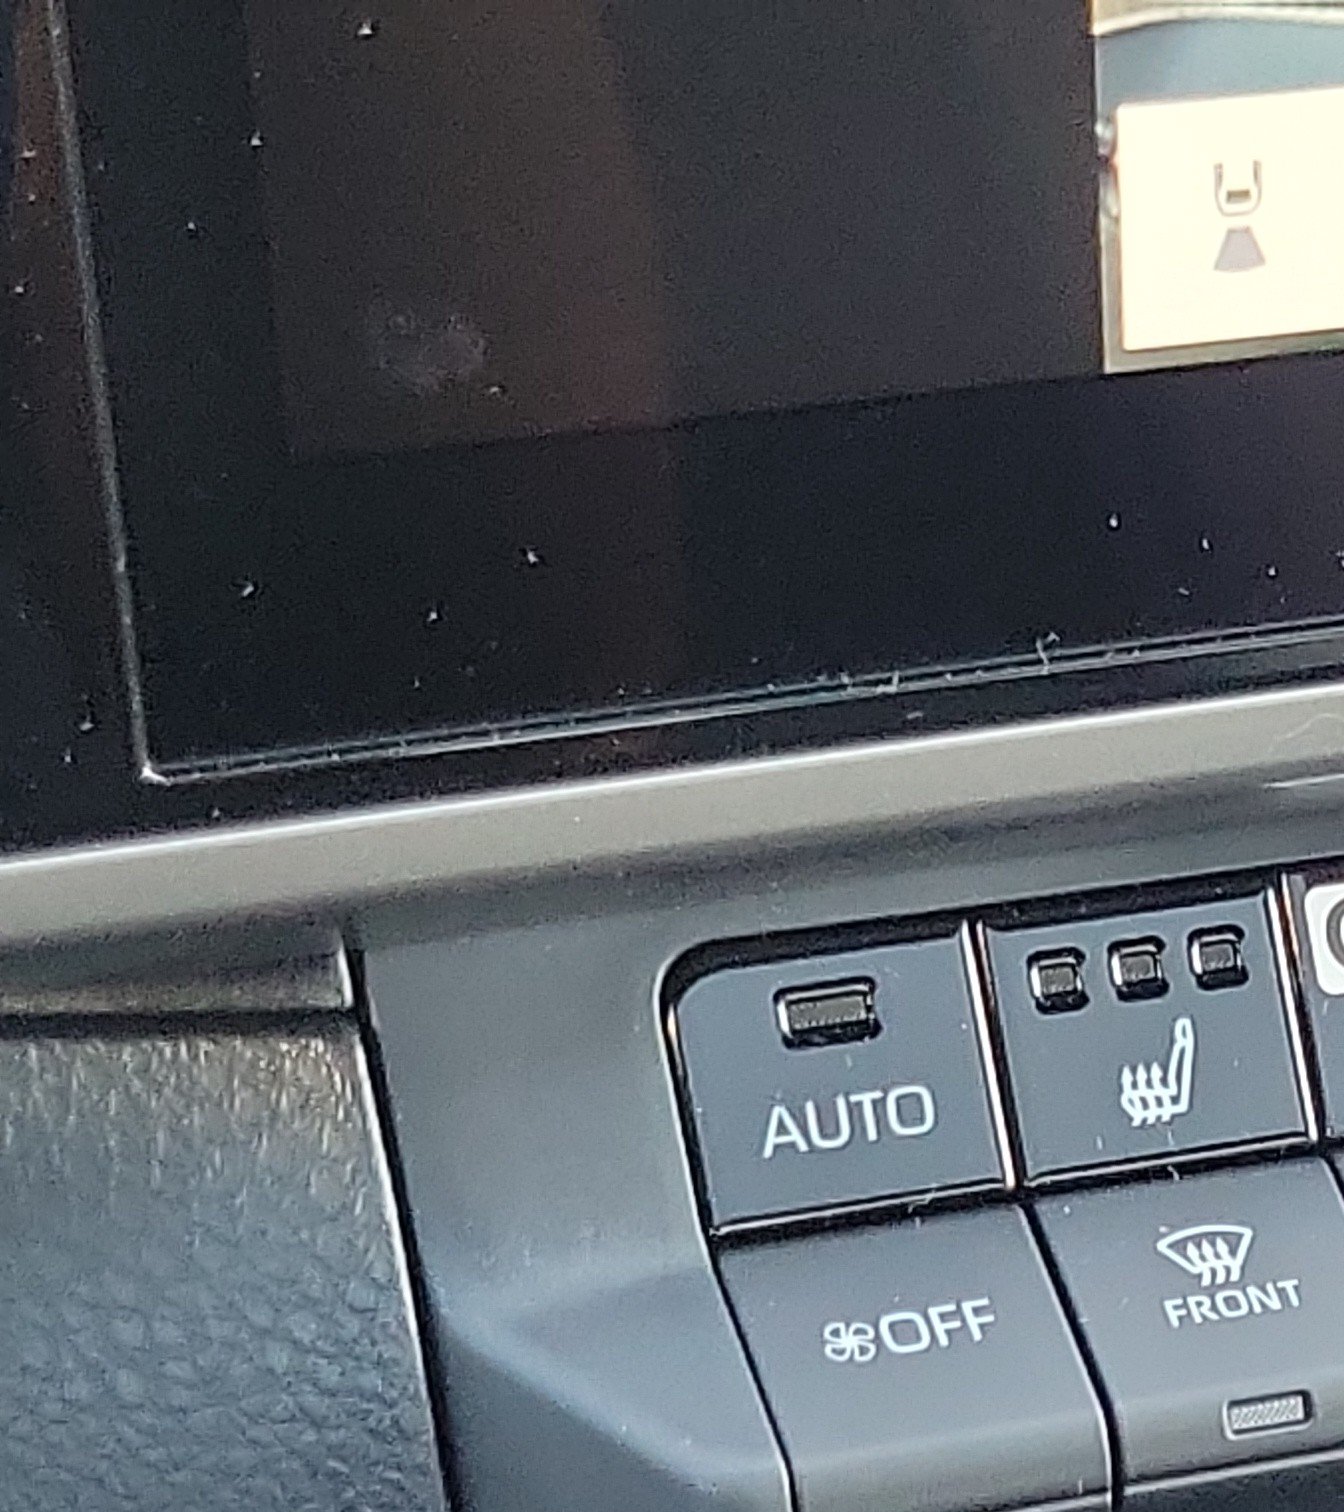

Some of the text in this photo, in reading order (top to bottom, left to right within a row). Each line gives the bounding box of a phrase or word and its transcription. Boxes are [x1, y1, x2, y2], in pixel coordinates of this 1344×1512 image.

[762, 1084, 936, 1159] AUTO
[880, 1297, 996, 1353] OFF
[1164, 1278, 1301, 1328] FRONT
